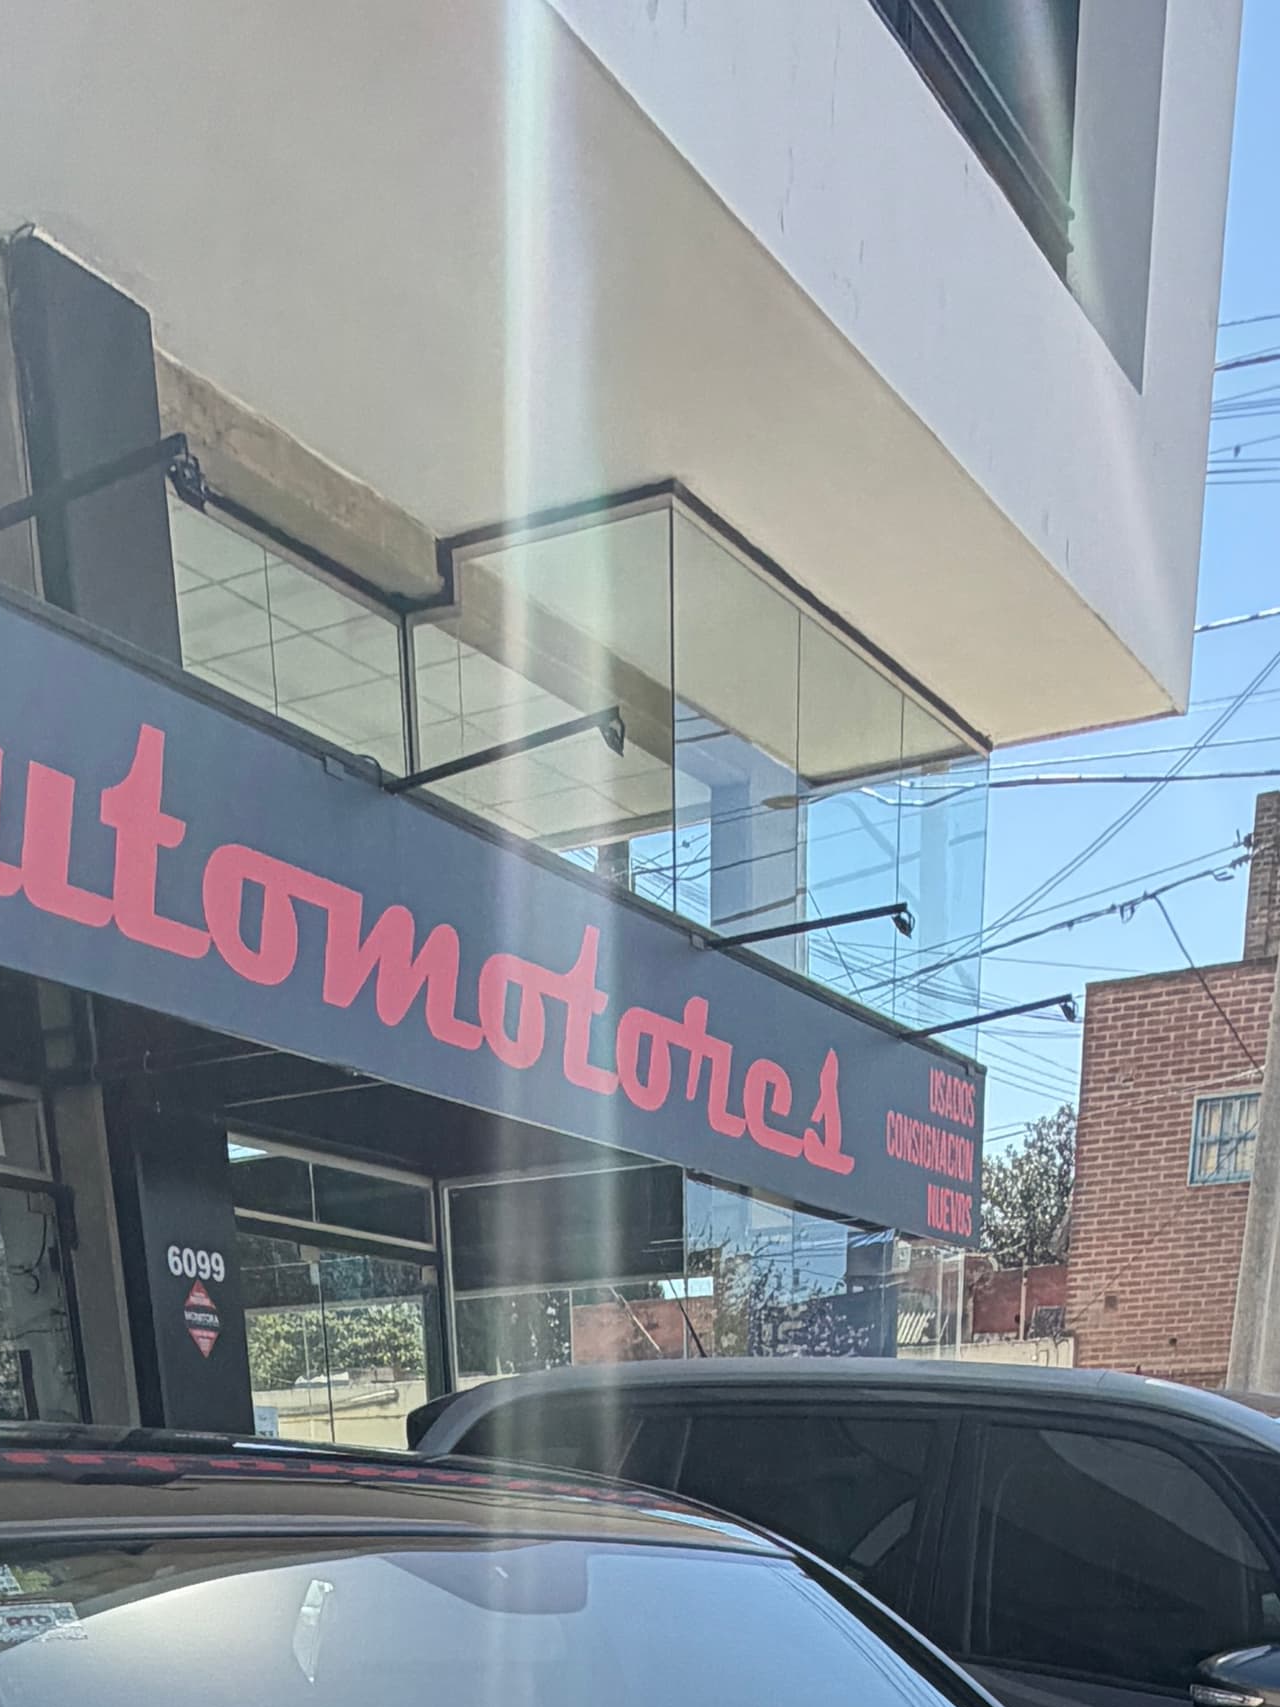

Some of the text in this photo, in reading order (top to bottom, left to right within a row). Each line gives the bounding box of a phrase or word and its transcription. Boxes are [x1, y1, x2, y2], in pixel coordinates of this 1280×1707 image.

[929, 1066, 976, 1128] USADOS
[886, 1110, 974, 1182] CONSIGNACION
[927, 1183, 973, 1237] NUEVOS
[167, 1245, 225, 1282] 6099
